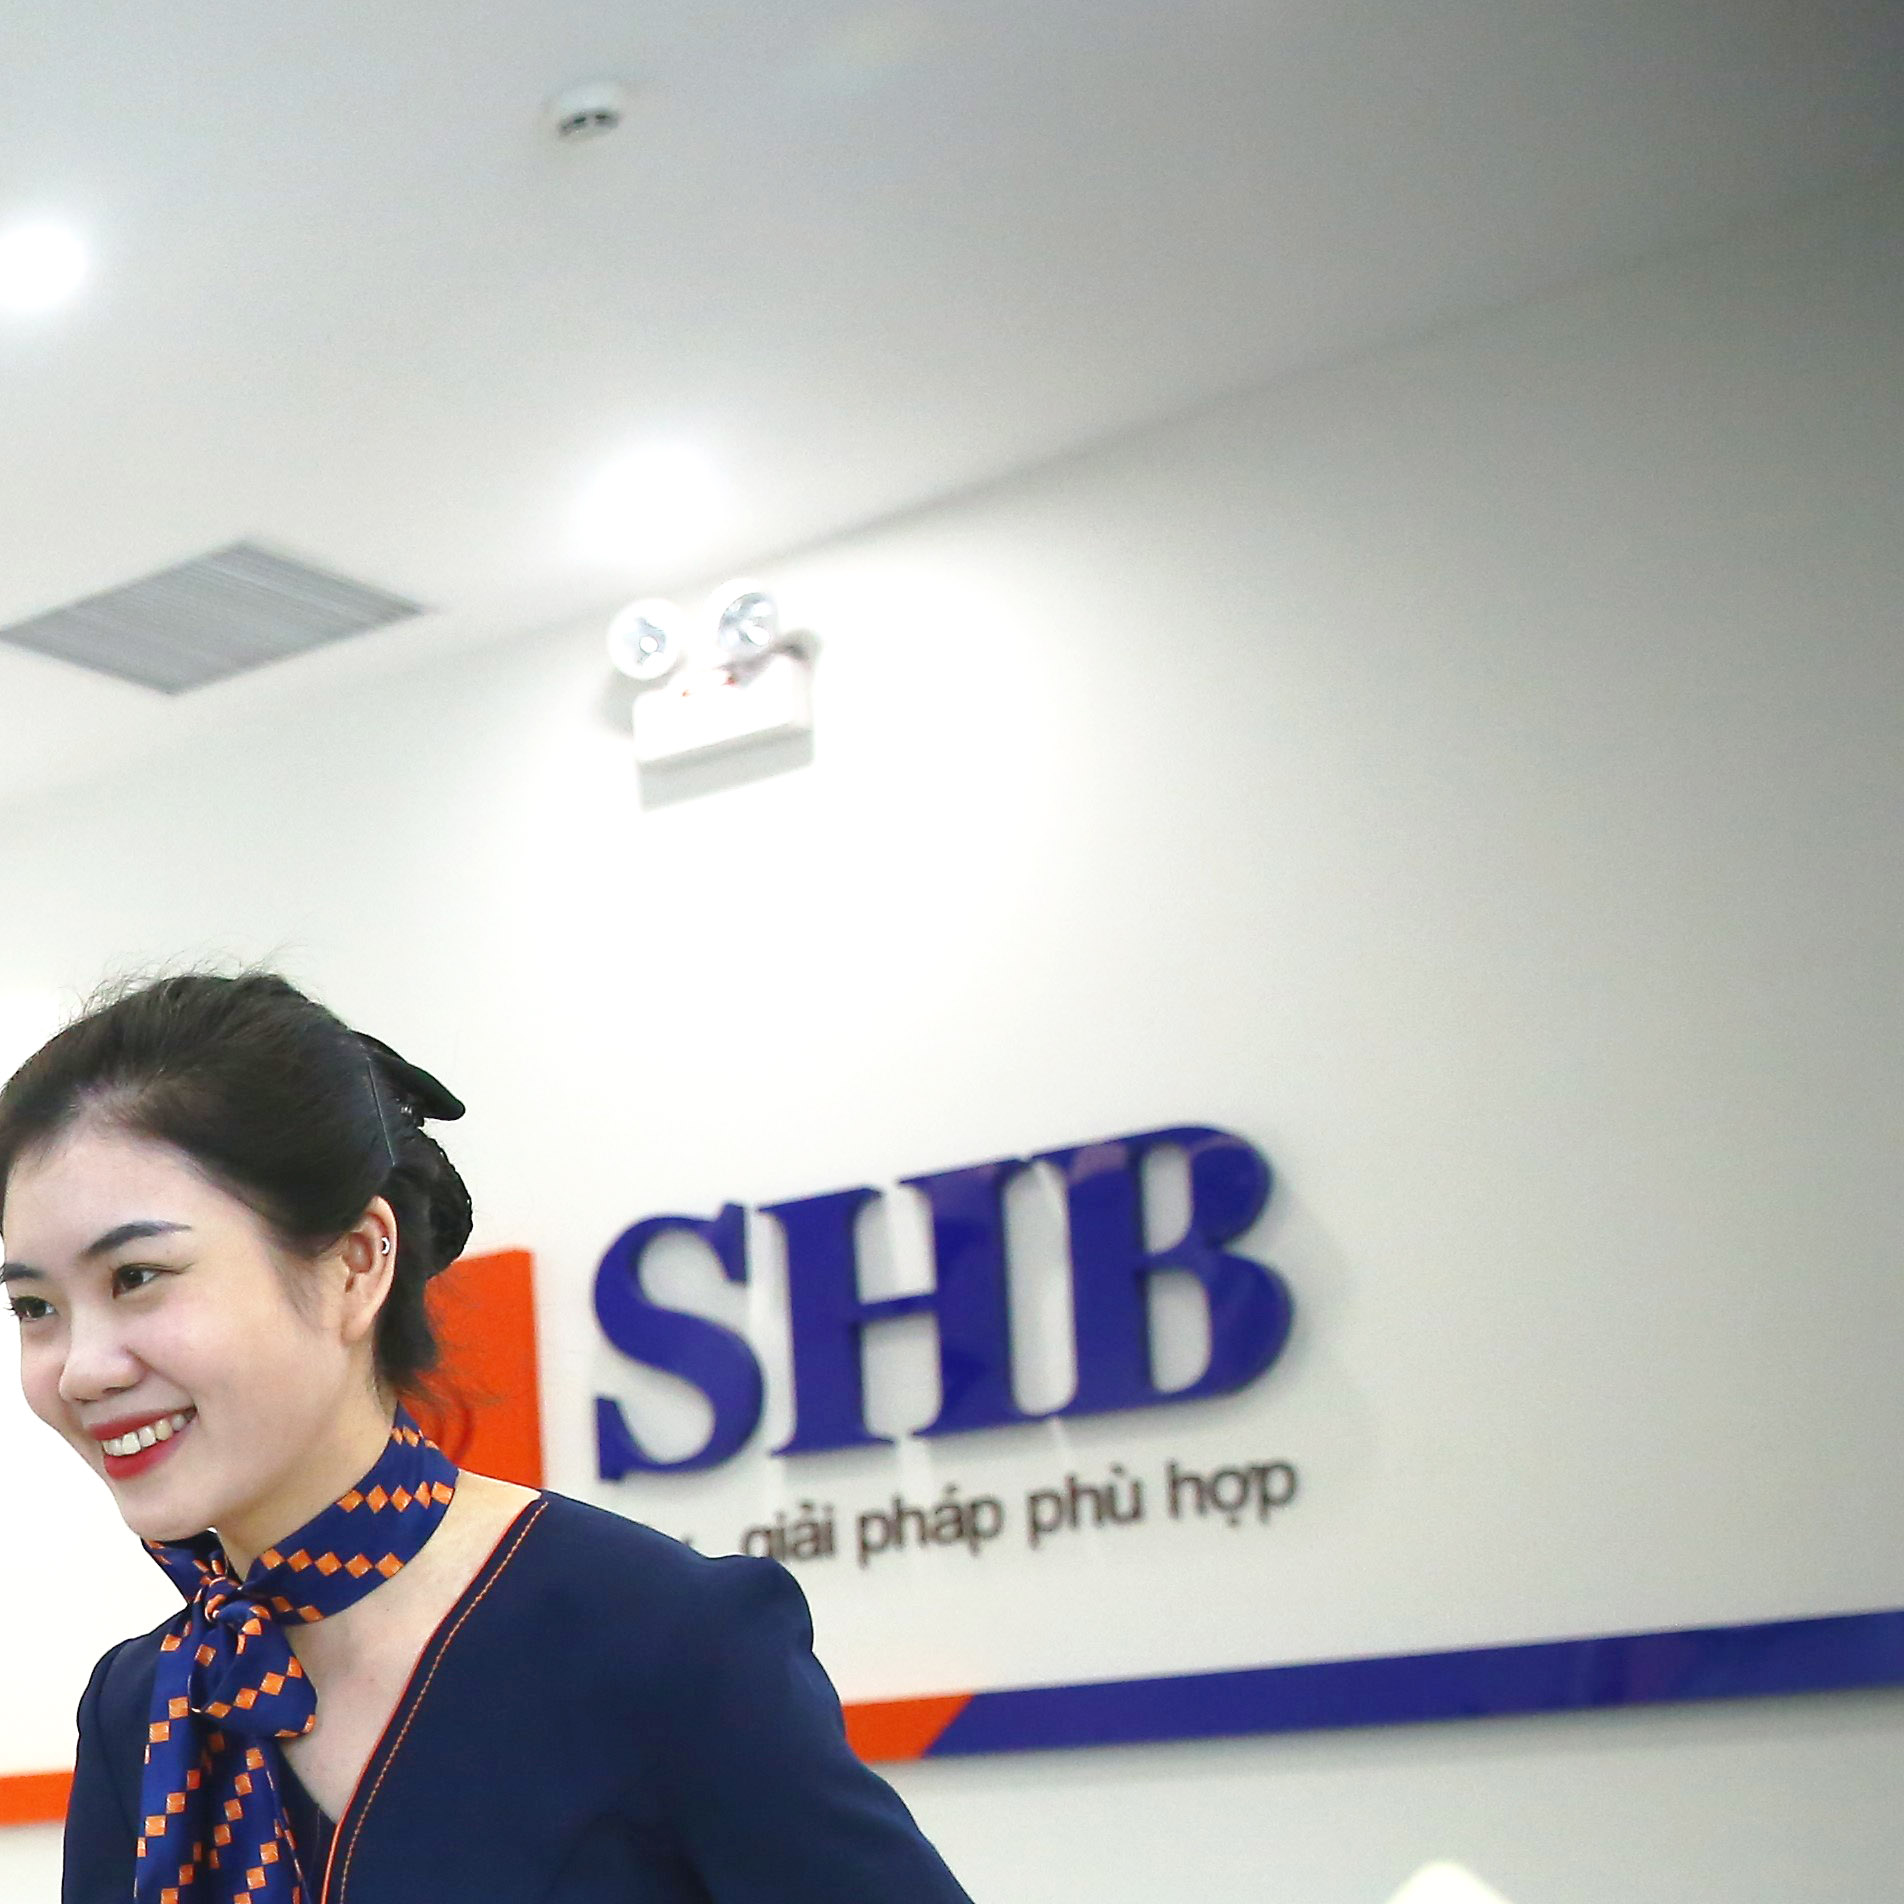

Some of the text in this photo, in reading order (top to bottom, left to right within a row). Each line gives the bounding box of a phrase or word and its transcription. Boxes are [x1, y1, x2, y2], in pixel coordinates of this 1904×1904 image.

[593, 1122, 1295, 1482] SHB
[857, 1483, 1005, 1567] pháp
[1027, 1463, 1147, 1549] phù
[1167, 1459, 1299, 1528] hợp
